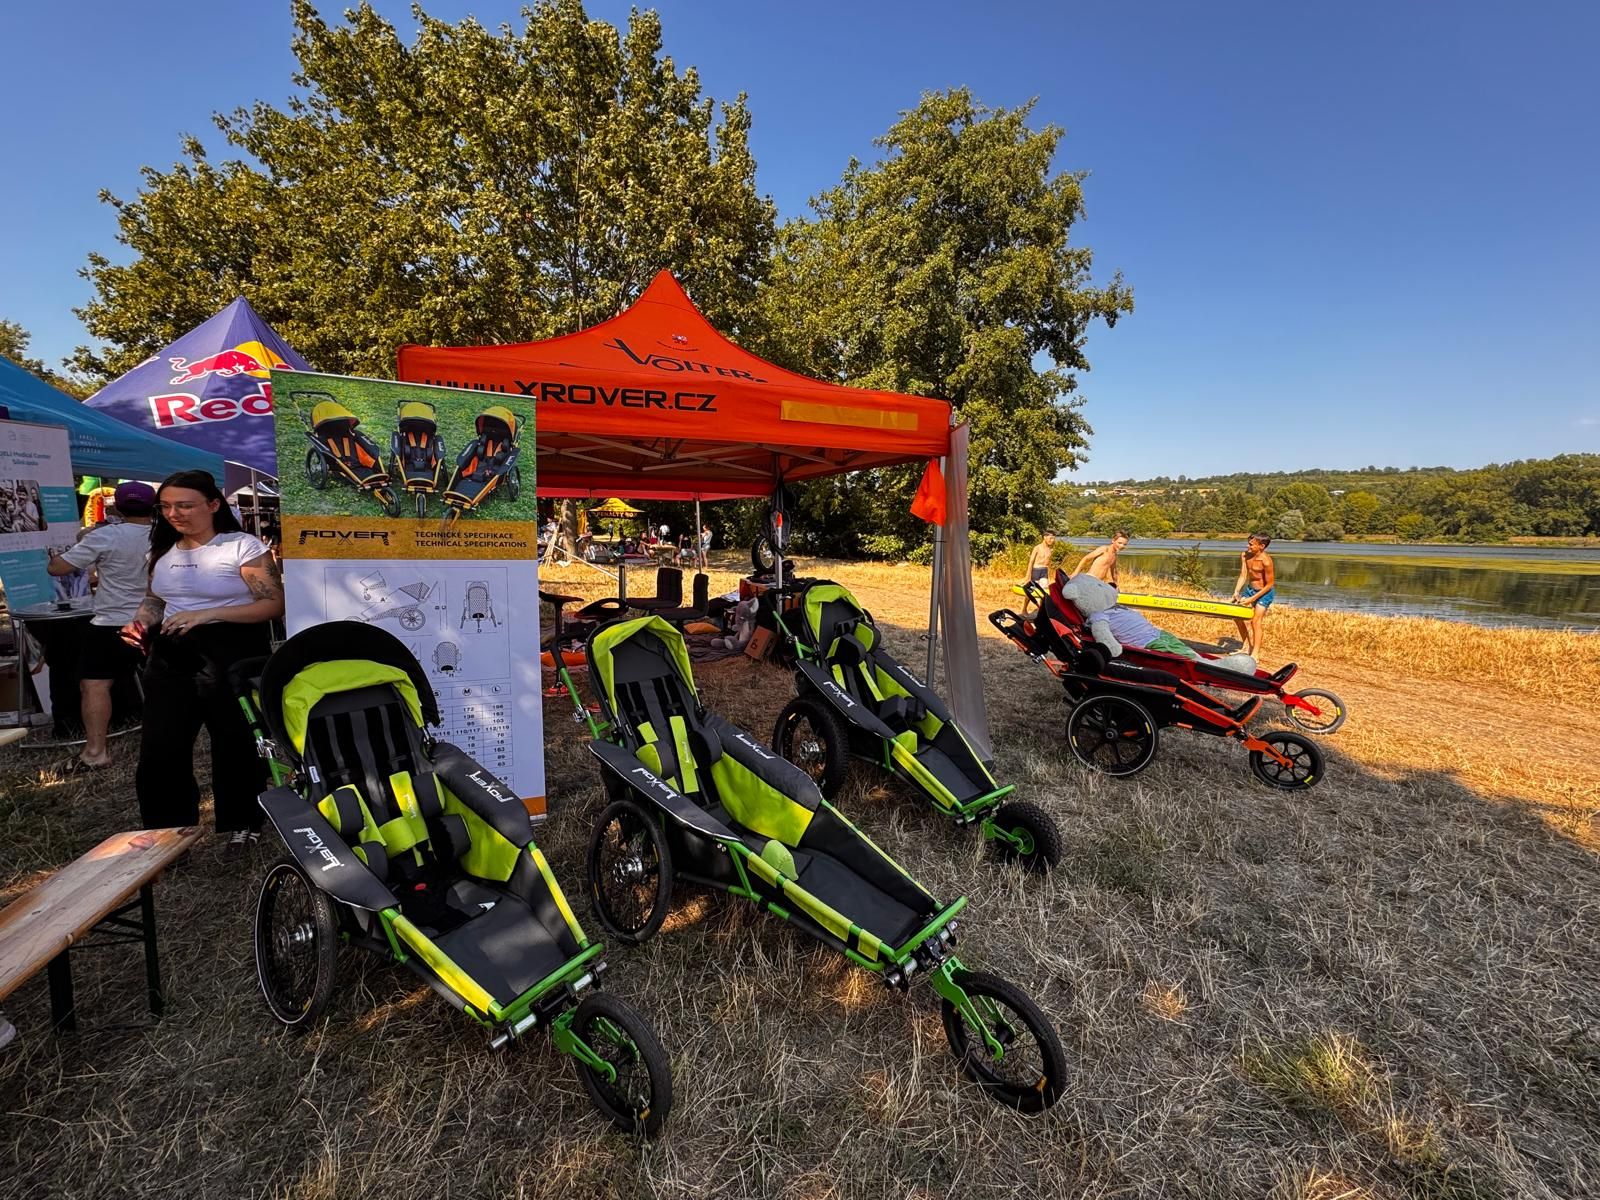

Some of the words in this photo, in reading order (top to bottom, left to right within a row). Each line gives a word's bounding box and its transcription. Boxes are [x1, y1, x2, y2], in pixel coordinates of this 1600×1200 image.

[603, 338, 768, 383] VOLTER
[148, 384, 273, 429] Red
[415, 540, 463, 548] TECHNICAL
[463, 540, 528, 548] SPECIFICATIONS
[463, 532, 513, 540] SPECIFIKACE
